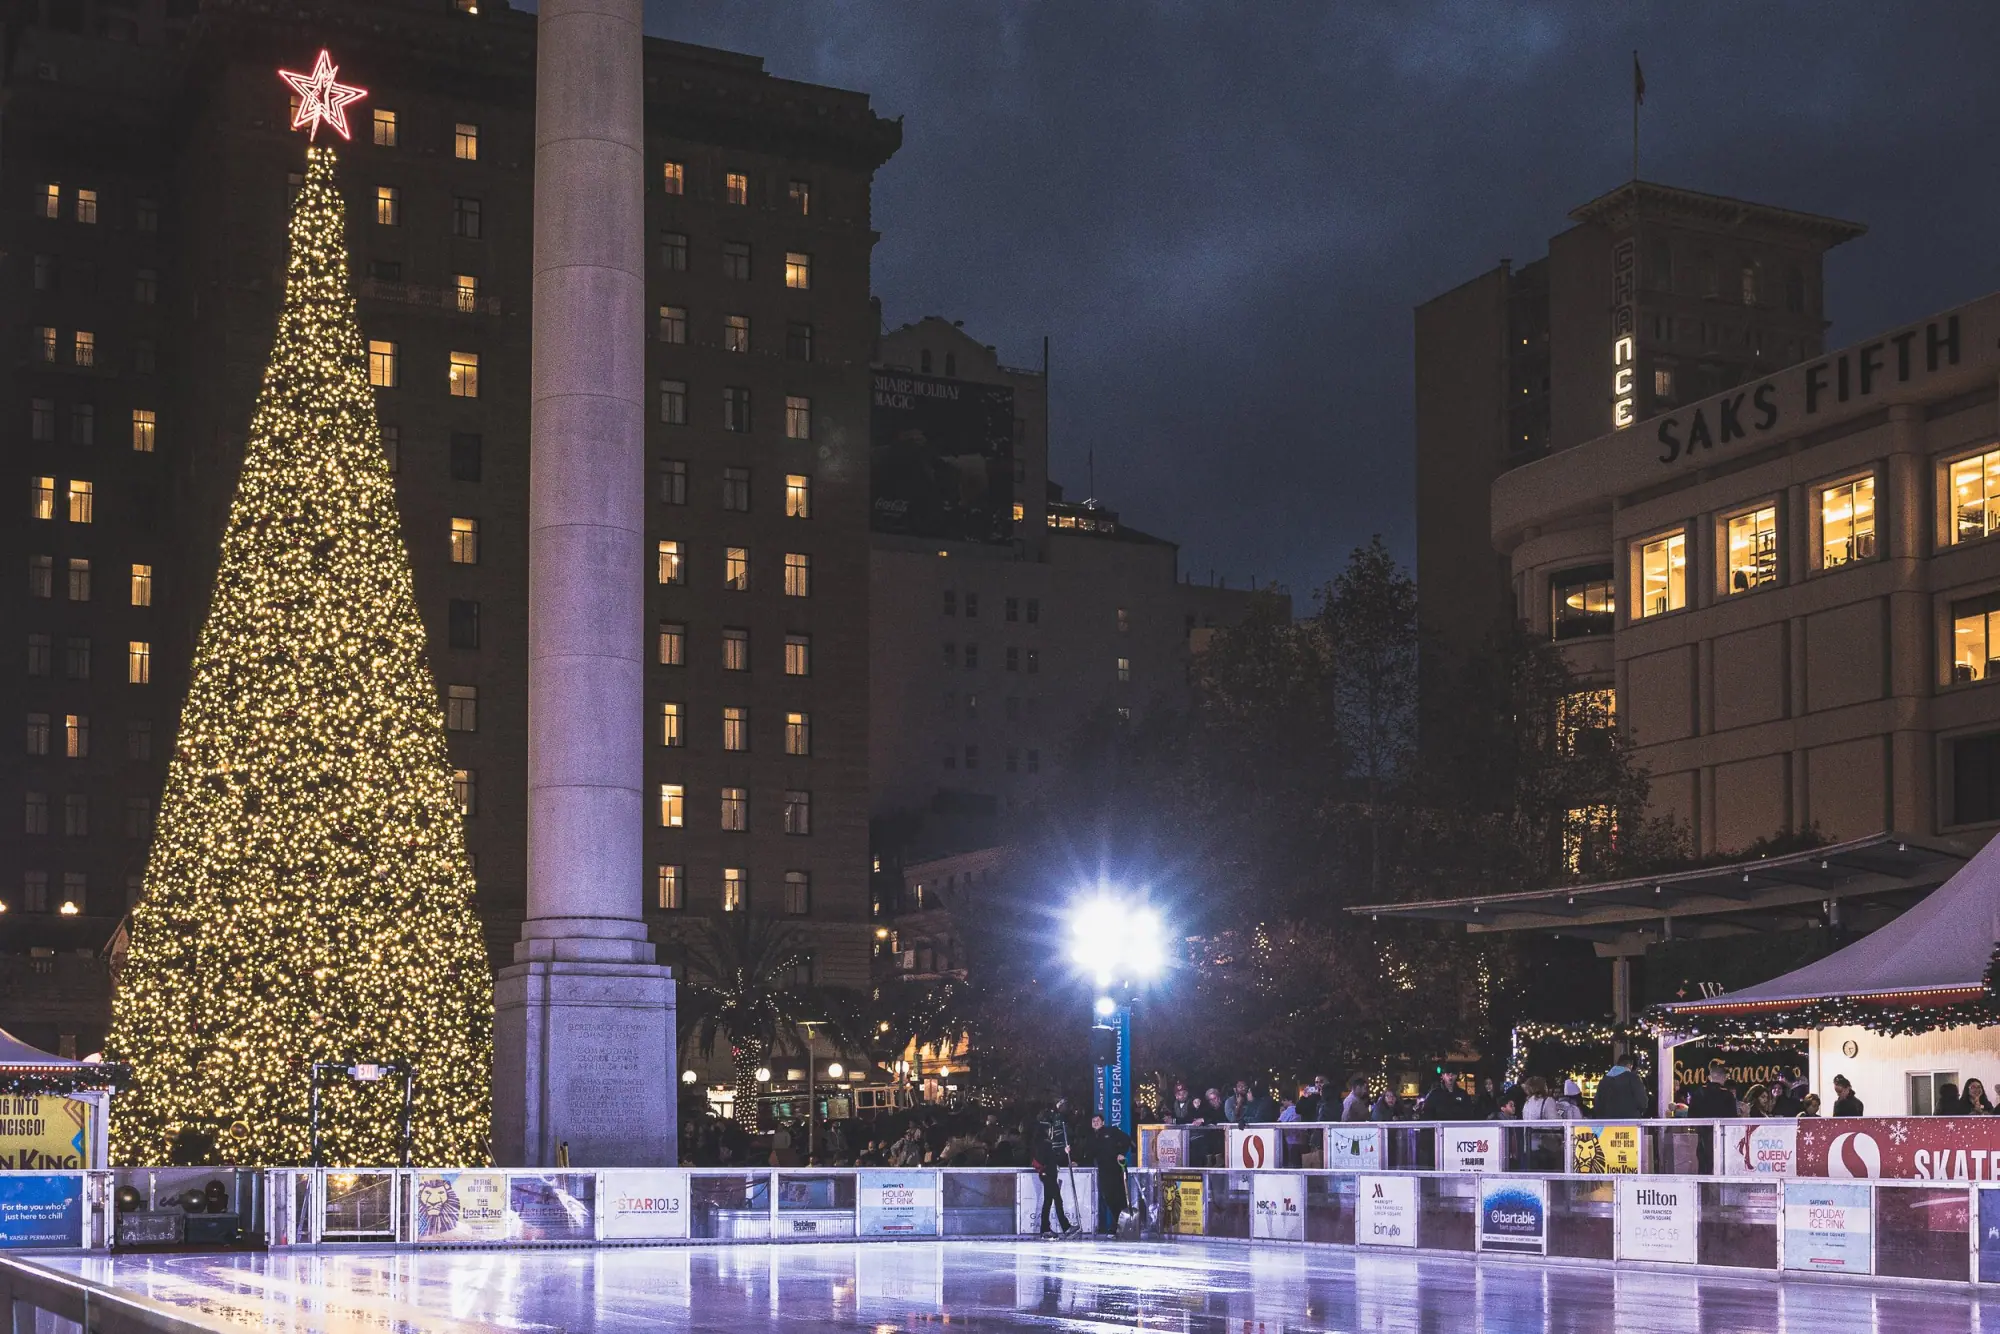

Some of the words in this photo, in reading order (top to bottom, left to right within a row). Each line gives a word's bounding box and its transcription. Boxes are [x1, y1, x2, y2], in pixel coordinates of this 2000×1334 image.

[875, 375, 912, 394] SHARE
[914, 380, 960, 400] HOLIDAY
[1657, 383, 1778, 464] SAKS
[1805, 314, 1961, 415] FIFTH
[875, 391, 915, 410] MAGIC
[358, 1066, 377, 1078] EXIT
[1674, 1060, 1708, 1085] San
[1708, 1058, 1801, 1083] ranciso
[13, 1099, 38, 1115] INTO
[1112, 1098, 1122, 1128] AISER
[1456, 1140, 1489, 1153] KTSF26
[1757, 1139, 1783, 1149] DRAG
[20, 1149, 78, 1169] KING
[1757, 1150, 1793, 1161] QUEENS
[1757, 1162, 1771, 1172] ON
[1771, 1162, 1786, 1172] ICE
[1914, 1149, 2000, 1180] SKATE
[1636, 1189, 1677, 1206] Hilton
[29, 1204, 44, 1213] you
[45, 1202, 66, 1210] who's
[1256, 1201, 1269, 1209] NBC
[5, 1212, 19, 1222] just
[20, 1212, 37, 1220] here
[48, 1212, 63, 1220] chill
[462, 1207, 481, 1219] LION
[482, 1207, 502, 1219] KING
[1500, 1210, 1535, 1224] bartable
[1809, 1208, 1845, 1219] HOLIDAY
[1809, 1219, 1823, 1229] ICE
[1825, 1219, 1845, 1229] RINK
[1635, 1227, 1665, 1241] PARC
